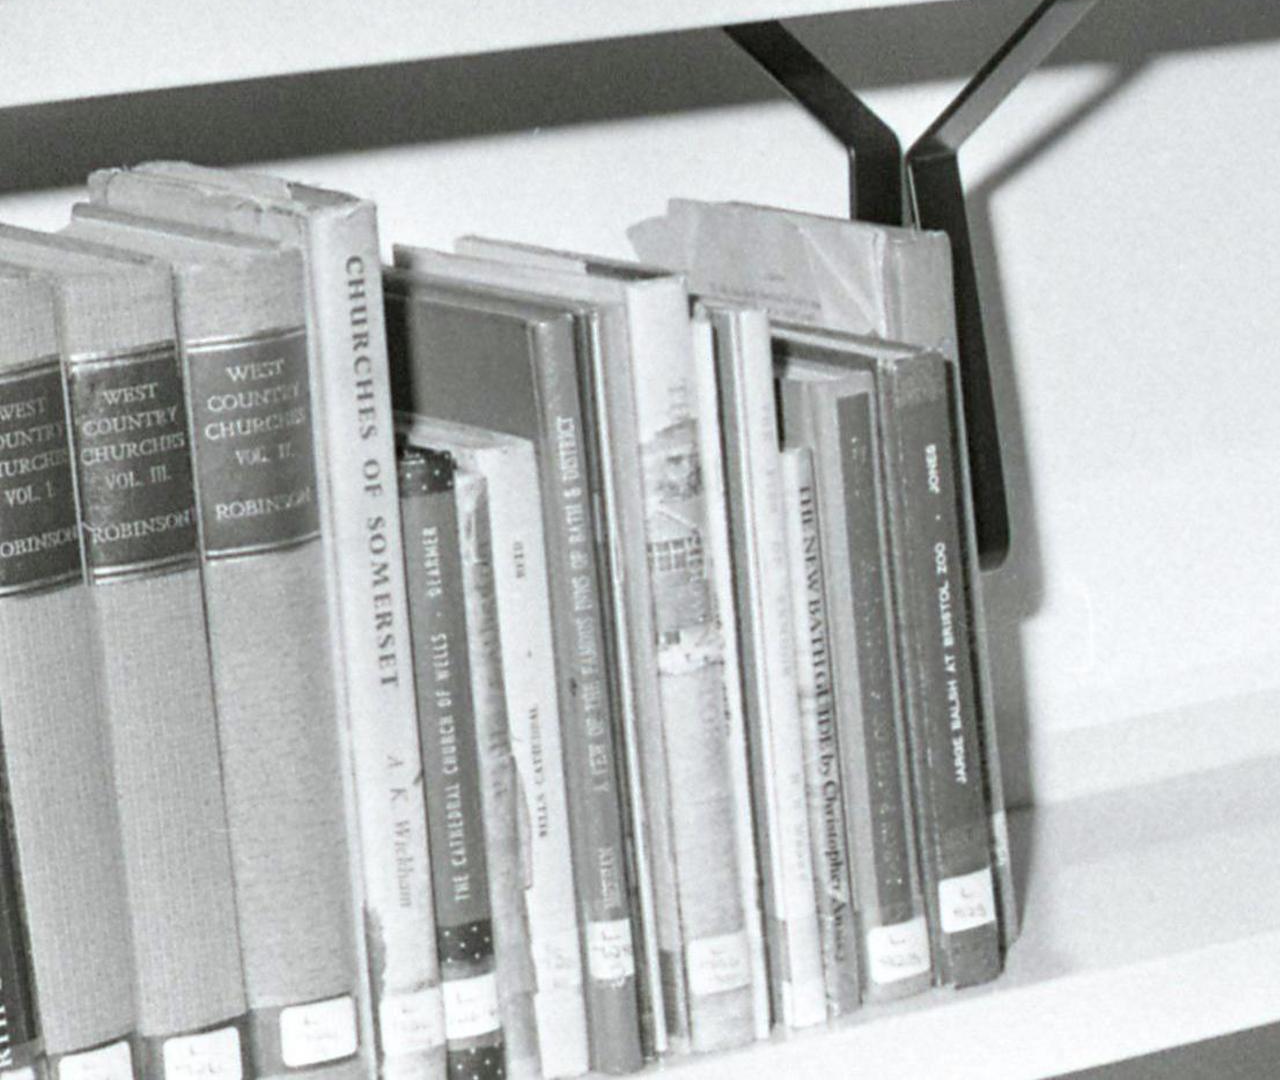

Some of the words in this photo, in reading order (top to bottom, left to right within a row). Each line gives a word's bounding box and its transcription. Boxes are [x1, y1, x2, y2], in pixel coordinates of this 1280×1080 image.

[345, 254, 378, 442] CHURCHES
[226, 358, 286, 383] WEST
[103, 381, 160, 406] WEST
[206, 380, 300, 413] COUNTRY
[0, 423, 63, 451] OUNTRY
[82, 405, 179, 438] COUNTRY
[203, 406, 306, 441] CHURCHES
[0, 449, 69, 478] URCHES
[80, 431, 186, 466] CHURCHES
[104, 470, 144, 492] VOL.
[361, 457, 384, 500] OF
[924, 443, 941, 494] JONES
[214, 485, 312, 521] ROBINSON
[799, 486, 815, 526] THE
[0, 525, 79, 559] OBINSON
[90, 509, 192, 545] ROBINSON
[566, 504, 588, 544] BATH
[803, 536, 820, 593] NEW
[934, 541, 949, 575] ZOO
[366, 516, 399, 688] SOMERSET
[938, 579, 955, 648] BRISTOL
[808, 599, 826, 667] BATH
[430, 633, 450, 682] WELLS
[943, 654, 957, 673] AT
[435, 689, 452, 708] OF
[813, 669, 833, 747] GUIDE
[946, 679, 962, 731] BALSH
[438, 715, 459, 776] CHURCH
[952, 734, 968, 785] JARGE
[818, 753, 835, 776] by
[443, 783, 468, 866] CATHEDRAL
[822, 779, 844, 895] Christopher
[454, 873, 471, 902] THE
